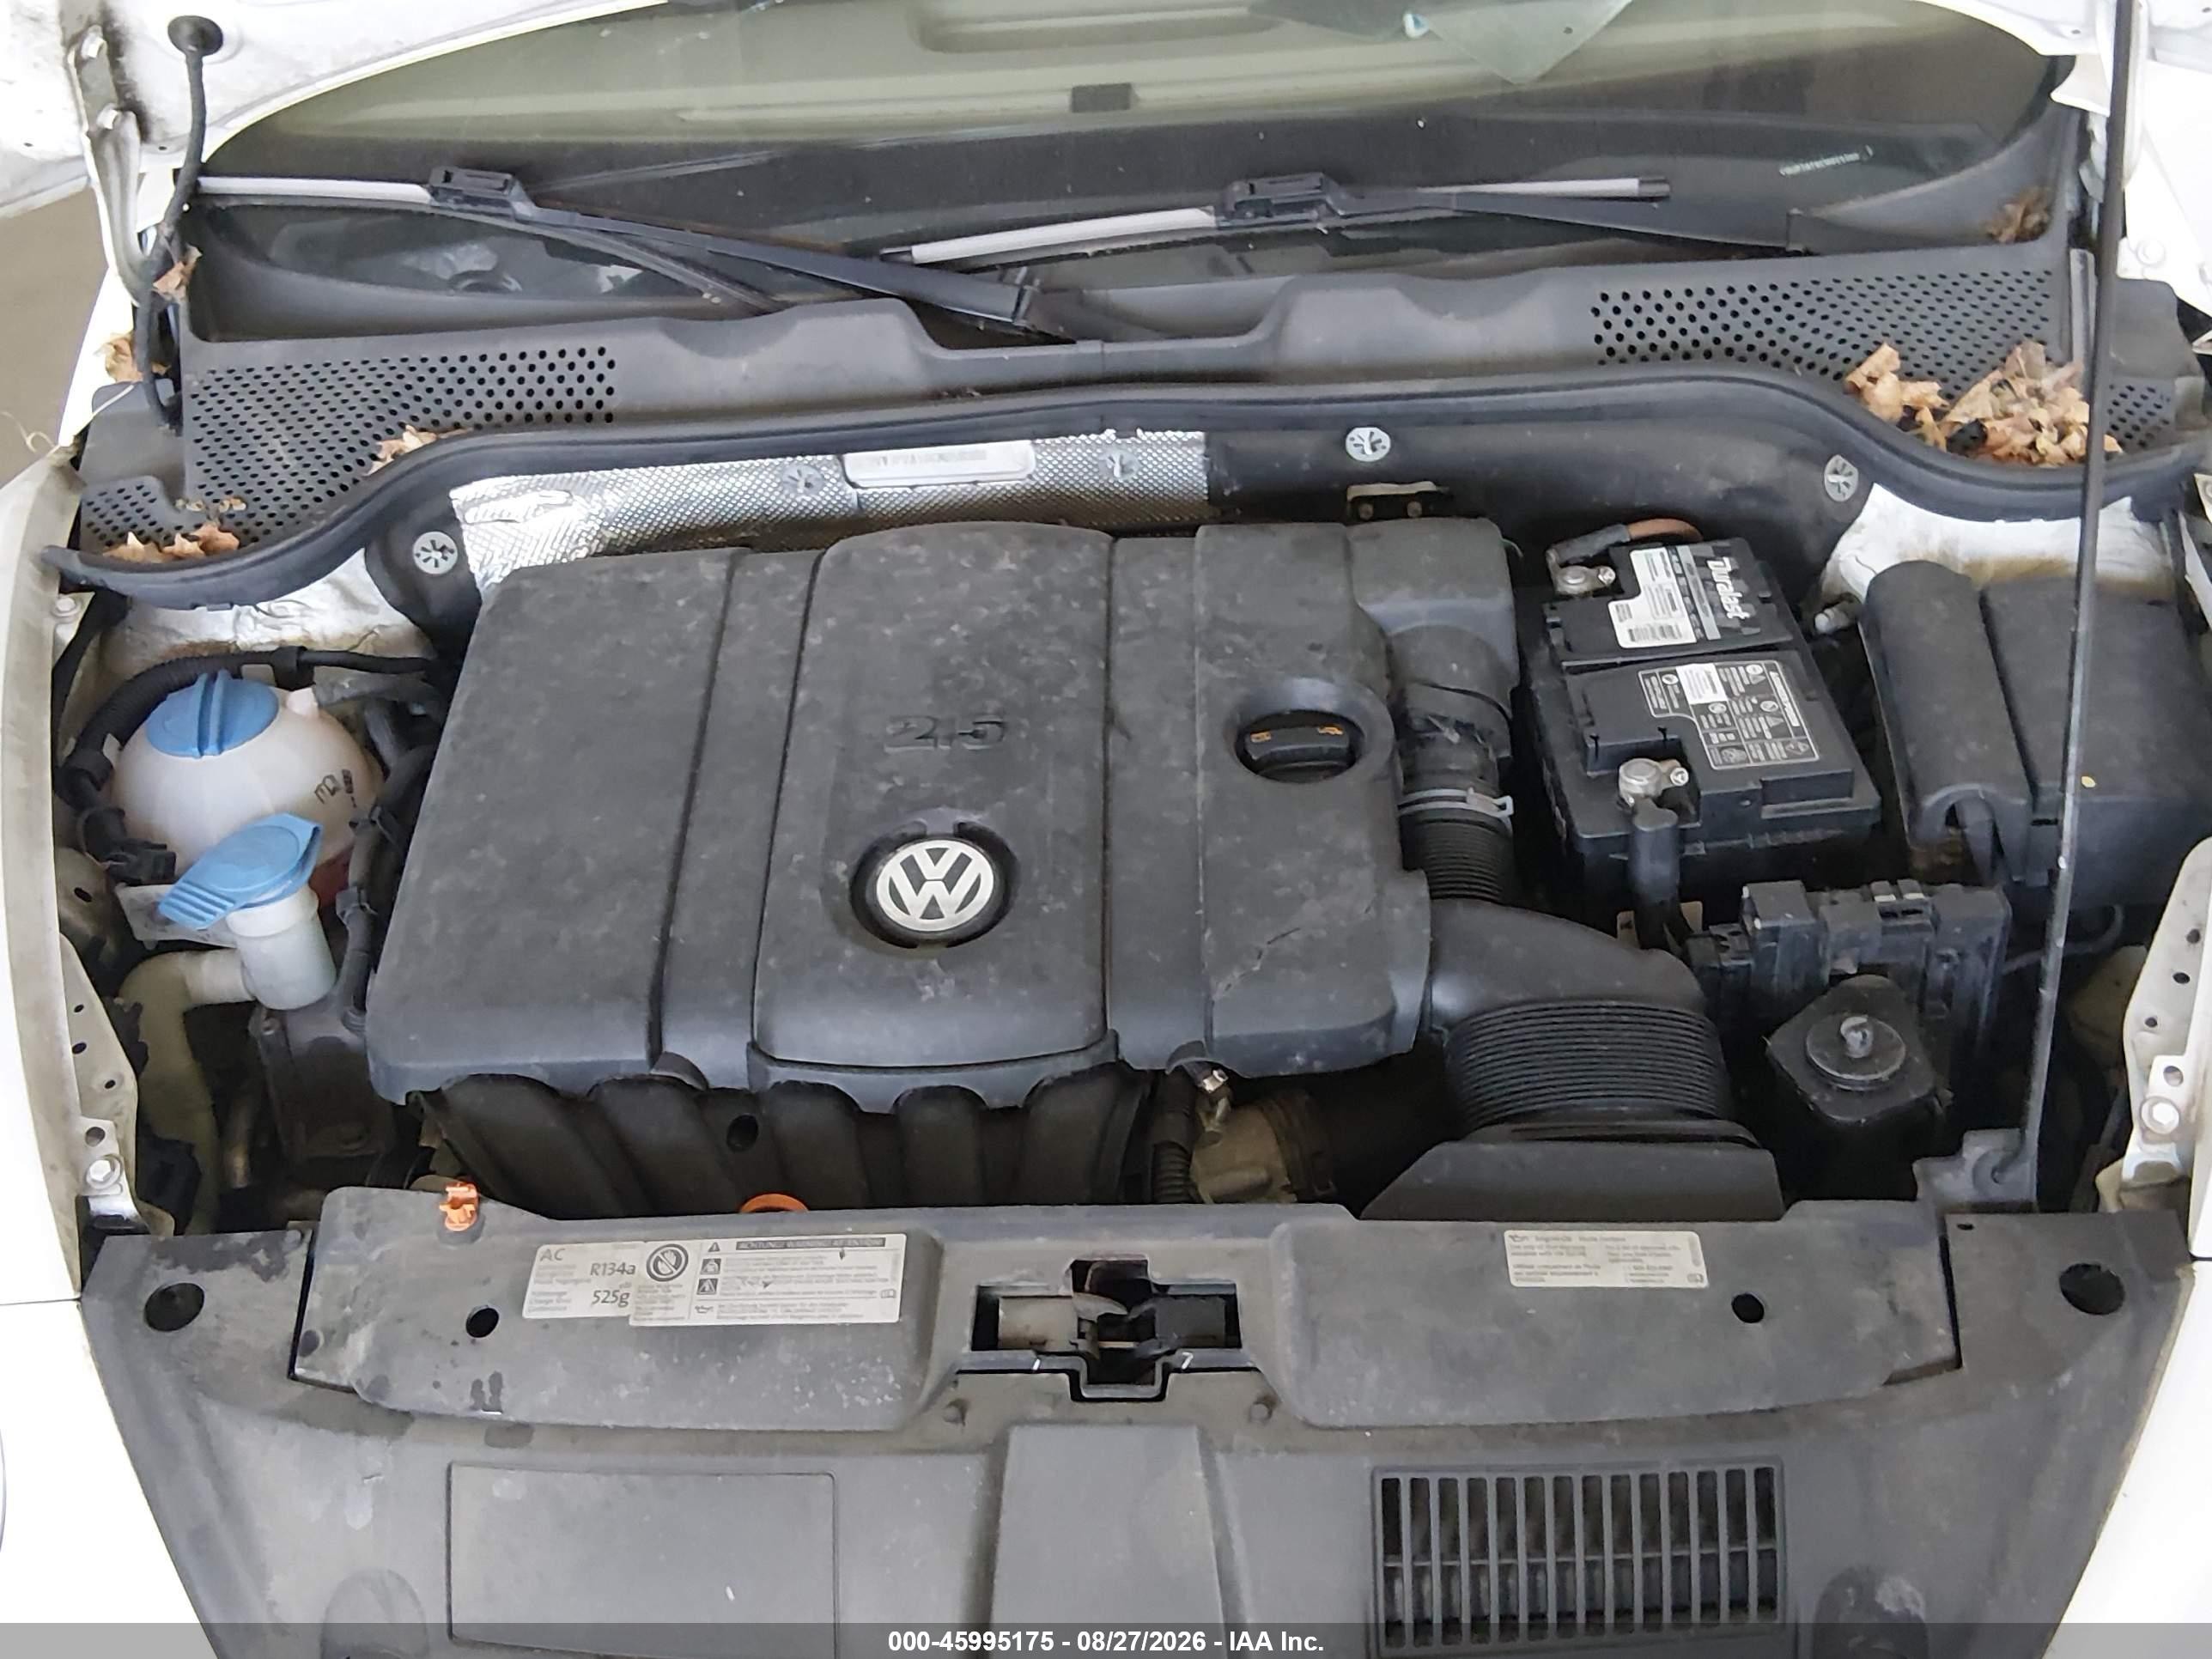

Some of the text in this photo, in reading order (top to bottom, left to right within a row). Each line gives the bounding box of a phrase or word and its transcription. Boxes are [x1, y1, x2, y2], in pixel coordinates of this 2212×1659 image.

[1706, 556, 1751, 620] Duralast
[876, 839, 994, 933] VW
[539, 1248, 566, 1262] AC
[590, 1261, 636, 1277] R134a
[591, 1289, 631, 1308] 525g
